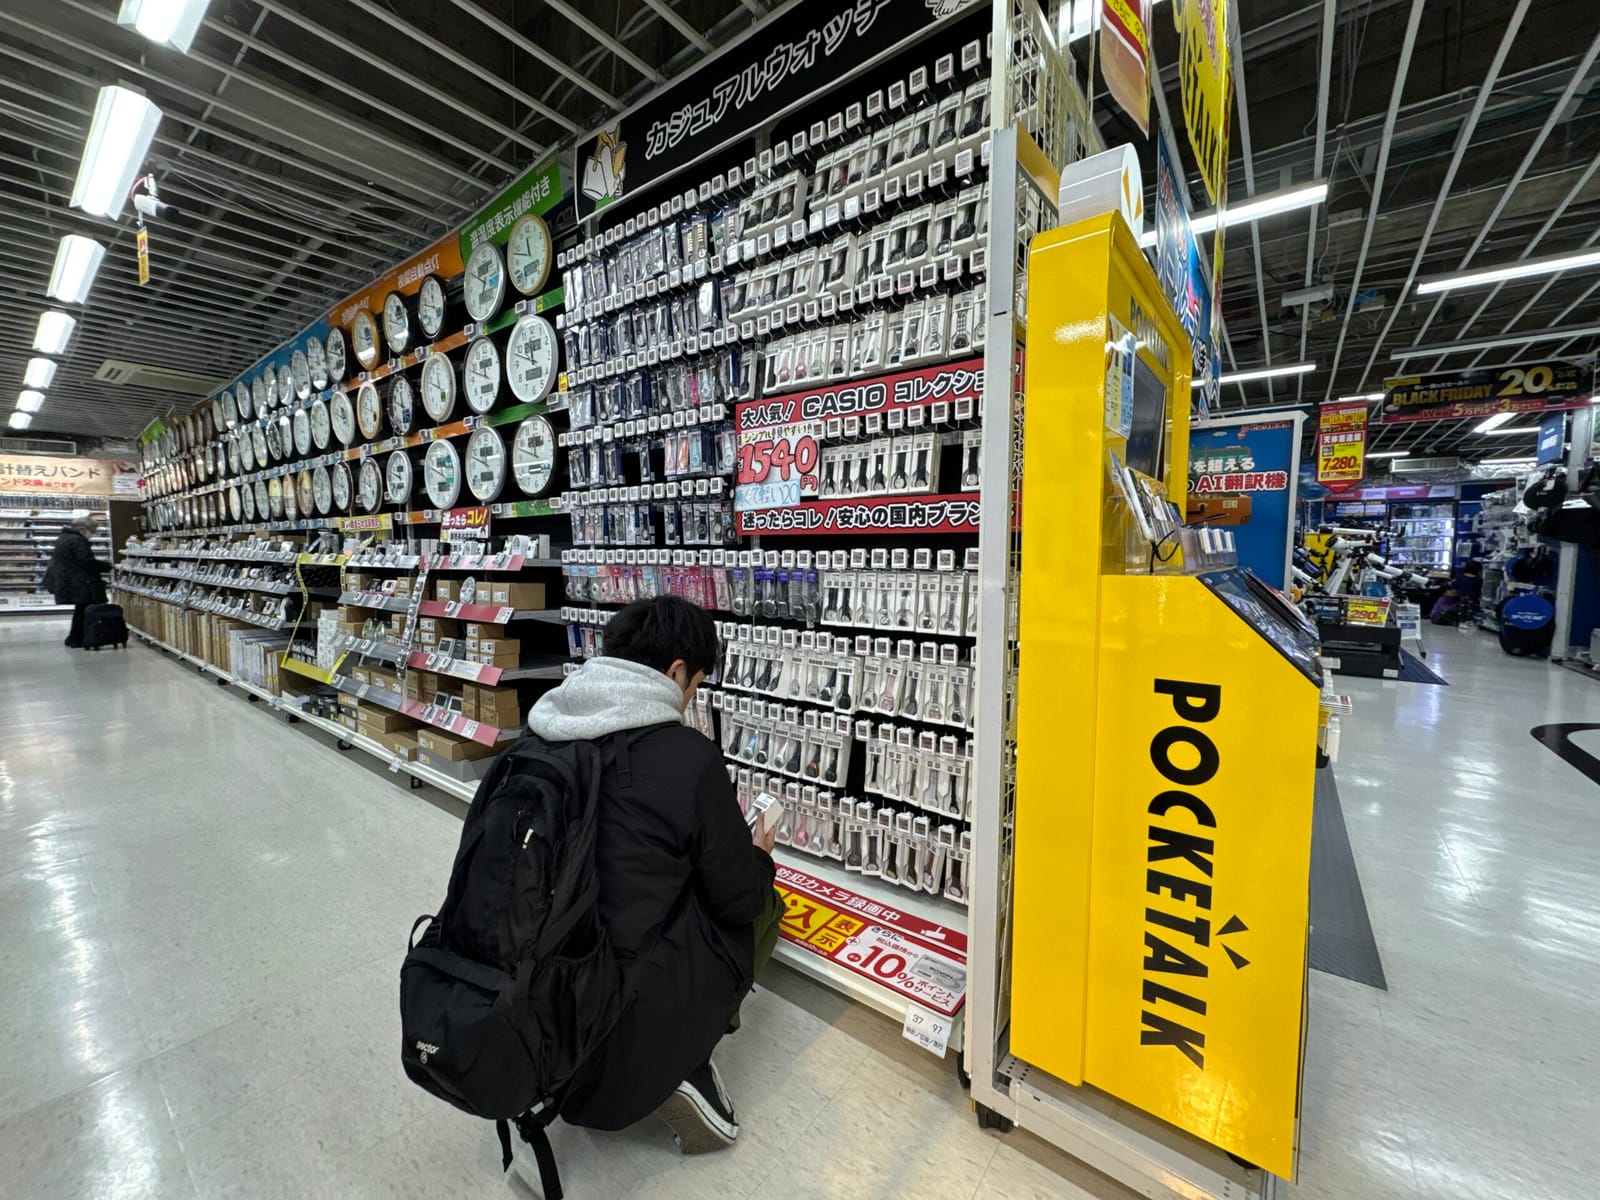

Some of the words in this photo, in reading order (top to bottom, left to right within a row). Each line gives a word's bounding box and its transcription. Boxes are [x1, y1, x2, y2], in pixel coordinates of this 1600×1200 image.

[645, 0, 892, 160] カジュアルウォッチ
[1393, 389, 1441, 406] BLACK
[1441, 383, 1493, 400] FRIDAY
[1497, 366, 1554, 396] 20
[741, 401, 796, 428] 大人気！
[802, 383, 887, 420] CASIO
[737, 435, 819, 485] 1540
[800, 474, 819, 491] 円
[1189, 456, 1256, 473] を超える
[1140, 678, 1221, 1071] POCKETALK
[776, 868, 901, 920] 防犯カメラ録画中
[871, 926, 903, 943] さらに
[913, 986, 951, 1008] サービス
[917, 980, 955, 1000] ポイント
